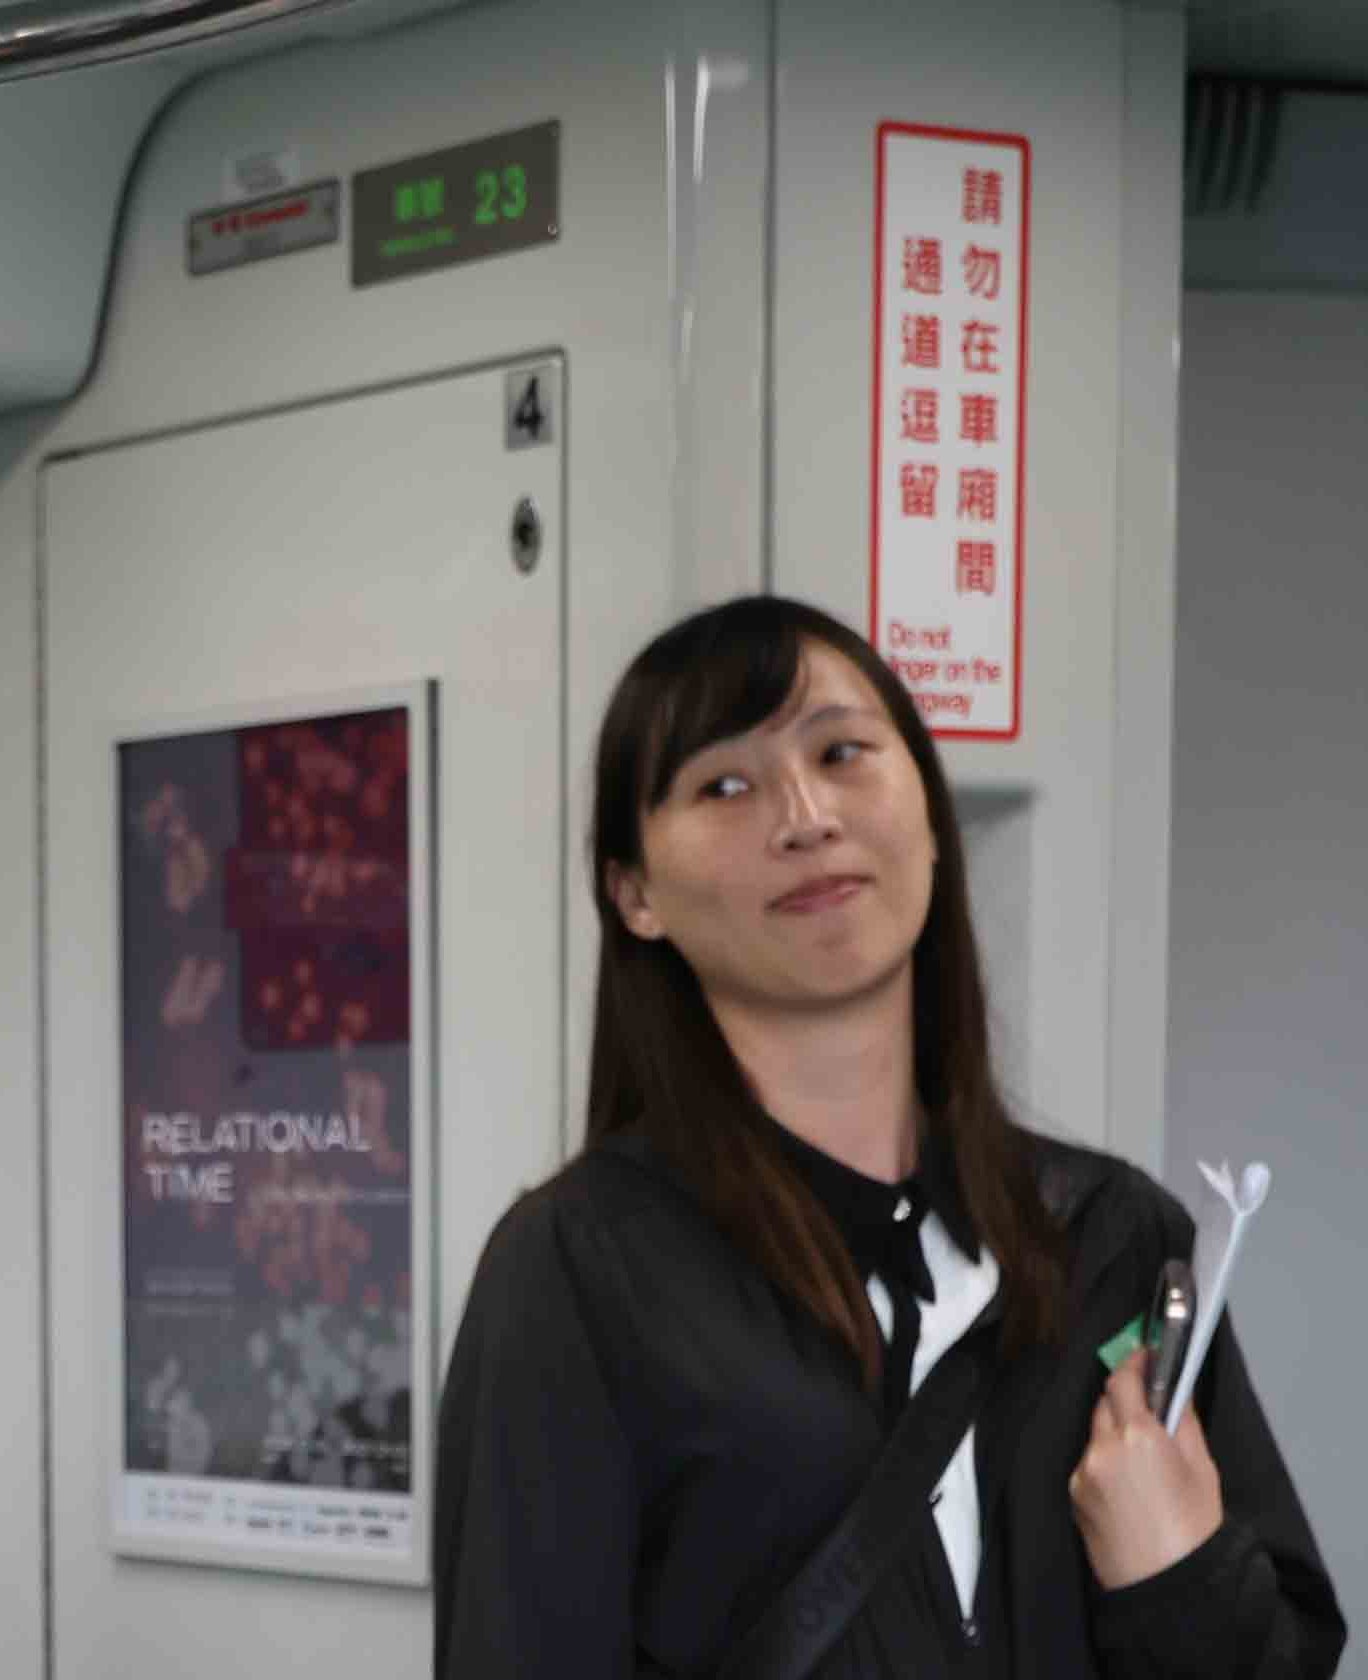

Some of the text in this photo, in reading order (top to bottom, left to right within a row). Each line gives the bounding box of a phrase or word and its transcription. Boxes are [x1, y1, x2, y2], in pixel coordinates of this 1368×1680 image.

[475, 165, 527, 225] 23
[513, 375, 545, 440] 4
[900, 236, 942, 520] 通道逗留
[956, 166, 1004, 597] 請勿在車廂間
[141, 1111, 372, 1154] RELATIONAL
[144, 1162, 235, 1203] TIME
